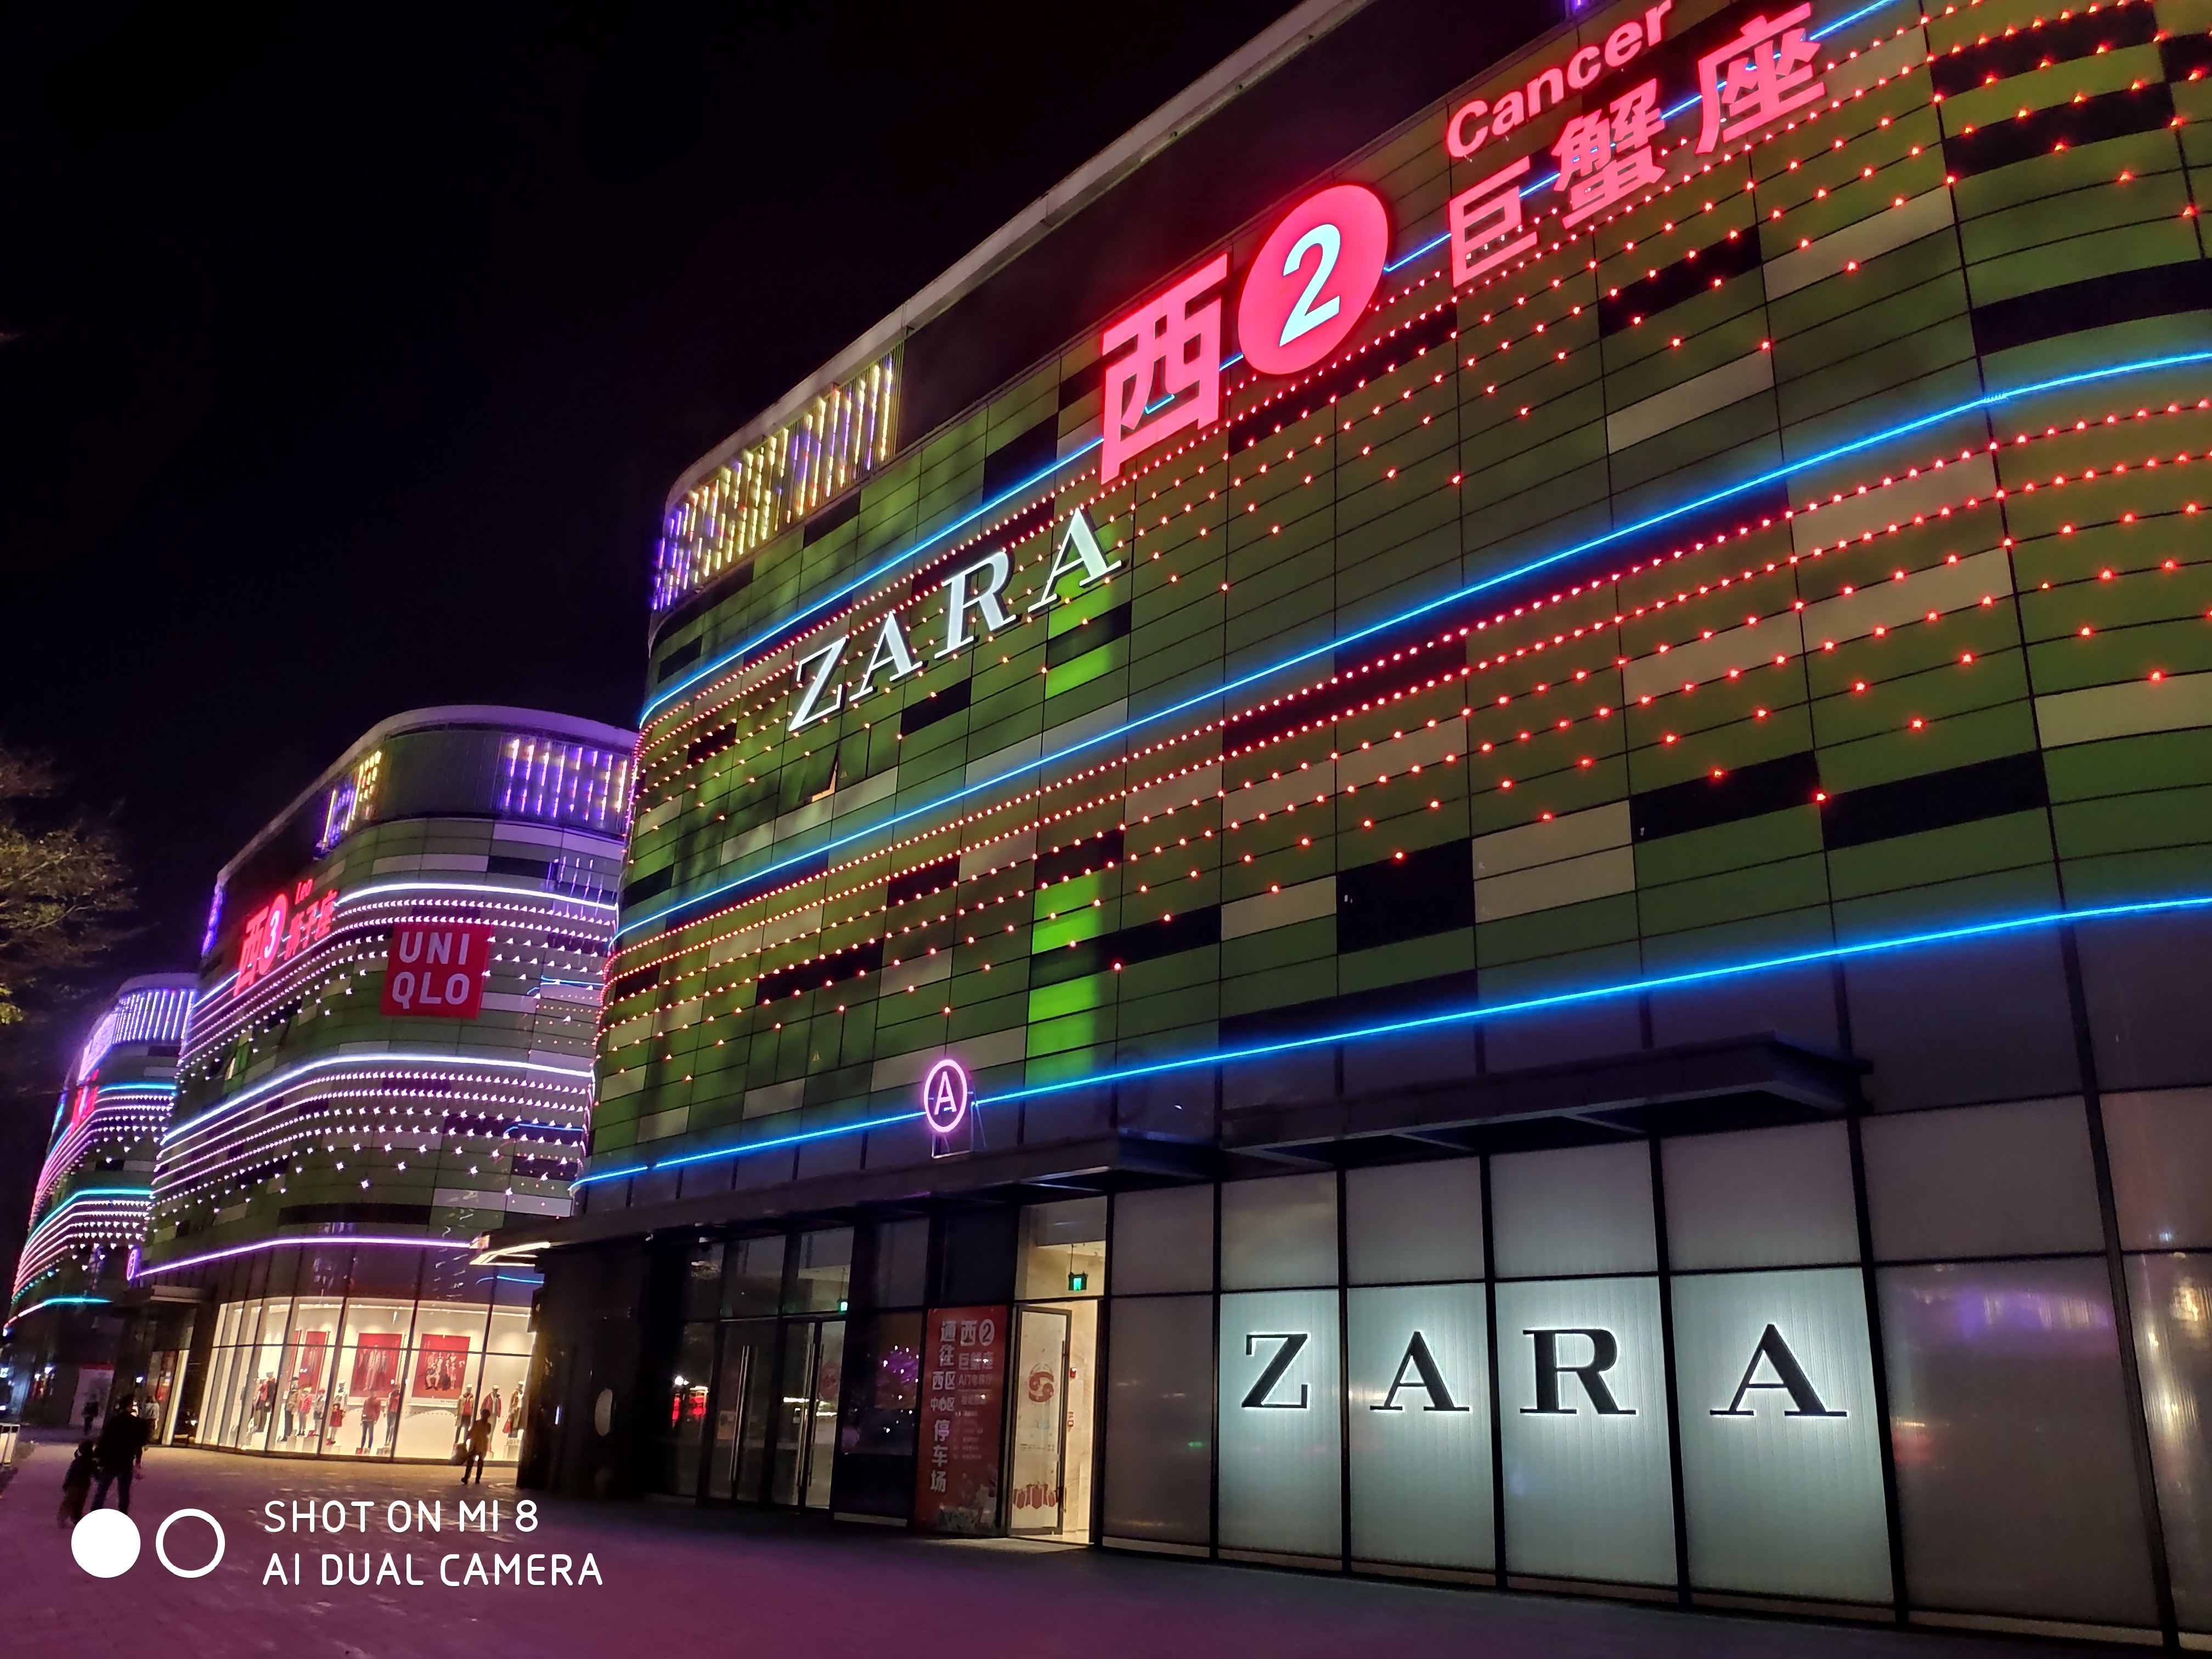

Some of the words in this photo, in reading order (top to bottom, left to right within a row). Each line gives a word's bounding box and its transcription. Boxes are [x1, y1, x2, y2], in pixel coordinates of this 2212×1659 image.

[1447, 0, 1673, 159] Cancer
[1448, 2, 1826, 288] 巨蟹座
[788, 507, 1123, 732] ZARA
[295, 878, 313, 905] Leo
[399, 932, 470, 965] UNI
[392, 972, 470, 1009] QLO
[934, 1070, 957, 1115] A
[939, 1319, 957, 1367] 通往
[932, 1370, 956, 1390] 西区
[1242, 1324, 1848, 1417] ZARA
[930, 1396, 955, 1412] 中心区
[930, 1419, 951, 1493] 停车场
